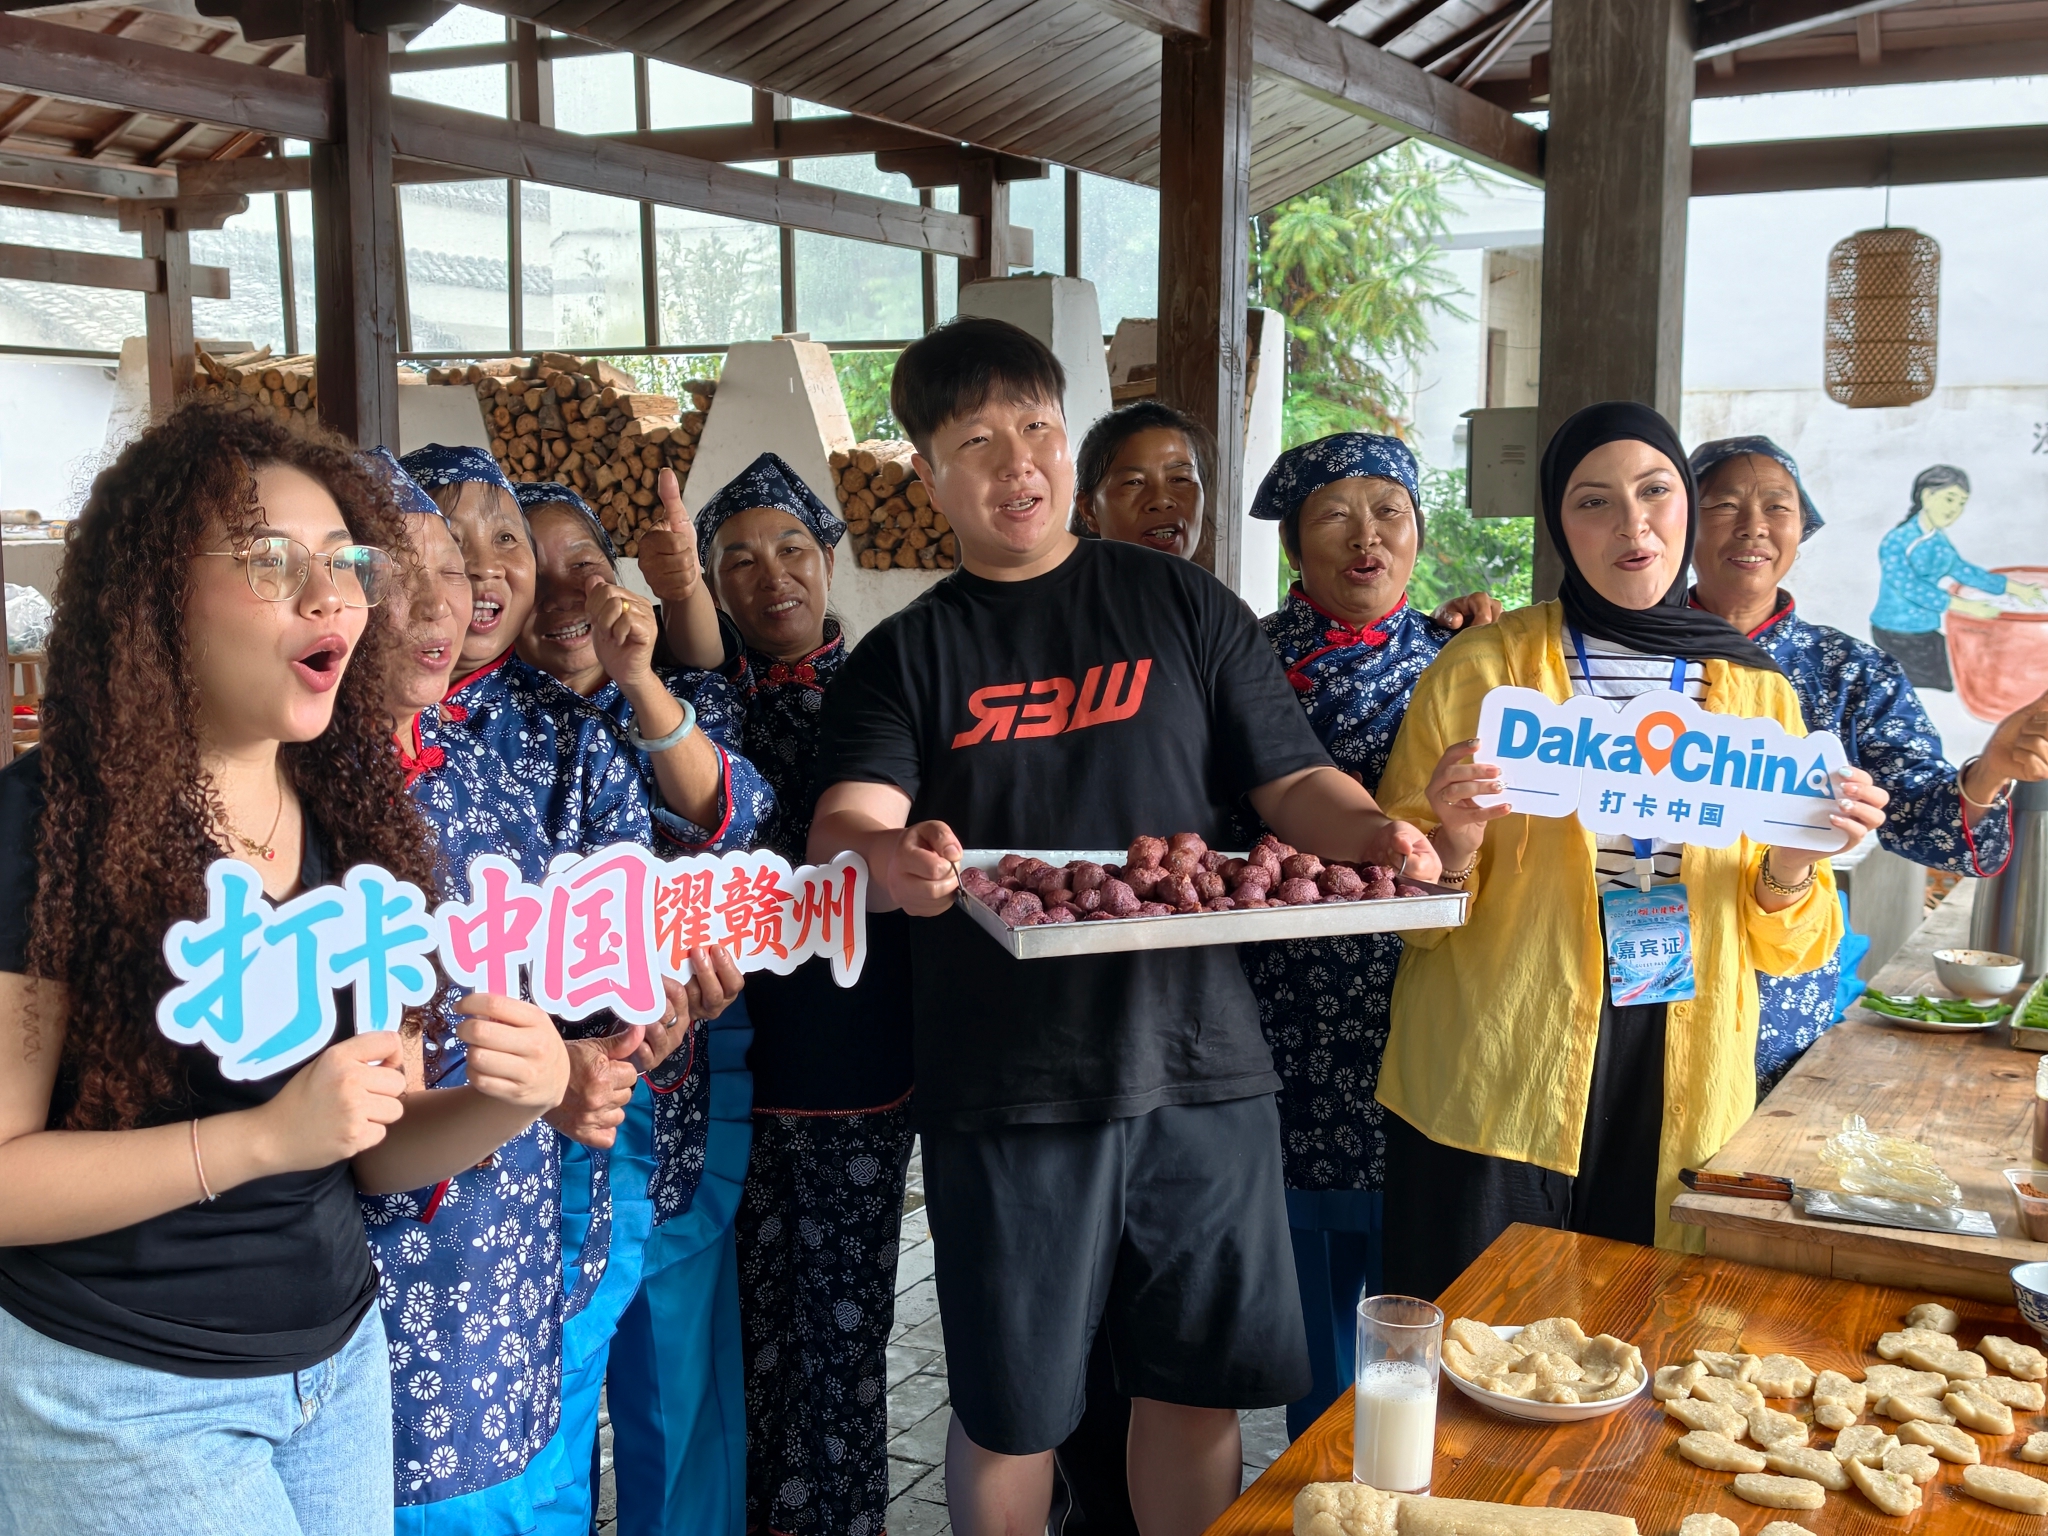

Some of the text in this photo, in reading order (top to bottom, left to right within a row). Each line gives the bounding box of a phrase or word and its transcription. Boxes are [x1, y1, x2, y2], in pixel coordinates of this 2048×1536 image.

[1496, 707, 1642, 775] Daka
[1599, 789, 1725, 828] 打卡中国
[1617, 937, 1681, 960] 嘉宾证
